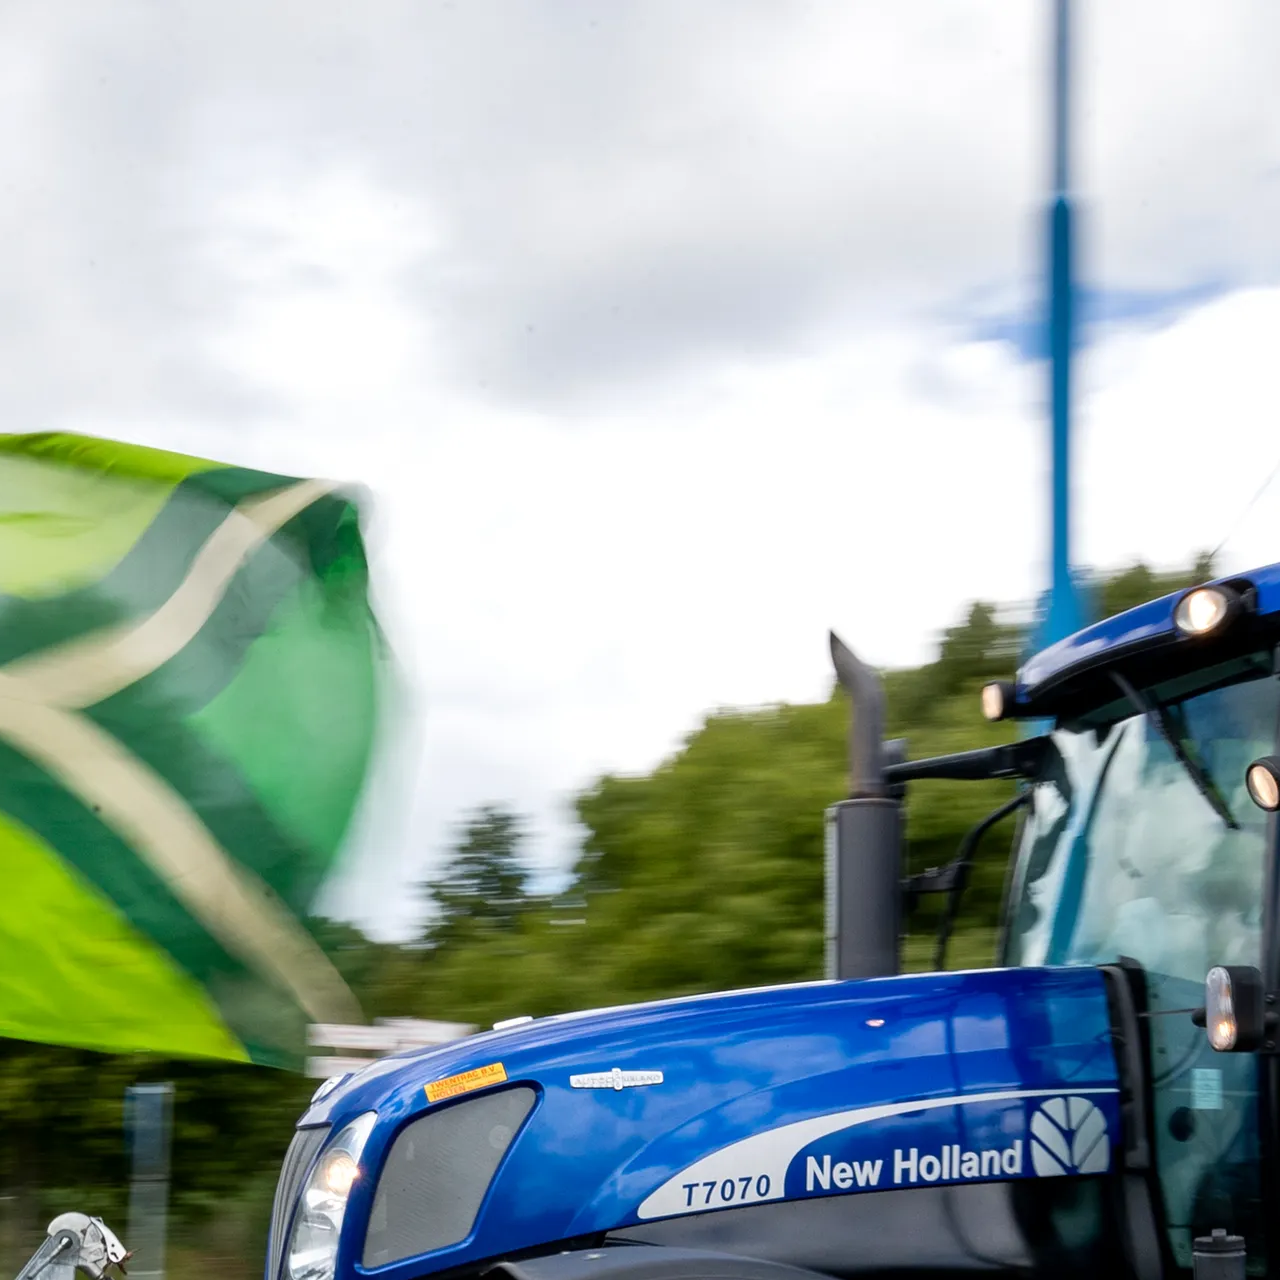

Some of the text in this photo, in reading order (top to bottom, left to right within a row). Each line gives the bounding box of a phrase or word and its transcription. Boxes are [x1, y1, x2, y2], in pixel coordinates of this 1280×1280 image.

[430, 1070, 479, 1090] TWENTRAC
[433, 1085, 466, 1100] HOLTEN
[806, 1139, 1024, 1192] New Holland
[683, 1174, 771, 1207] T7070
